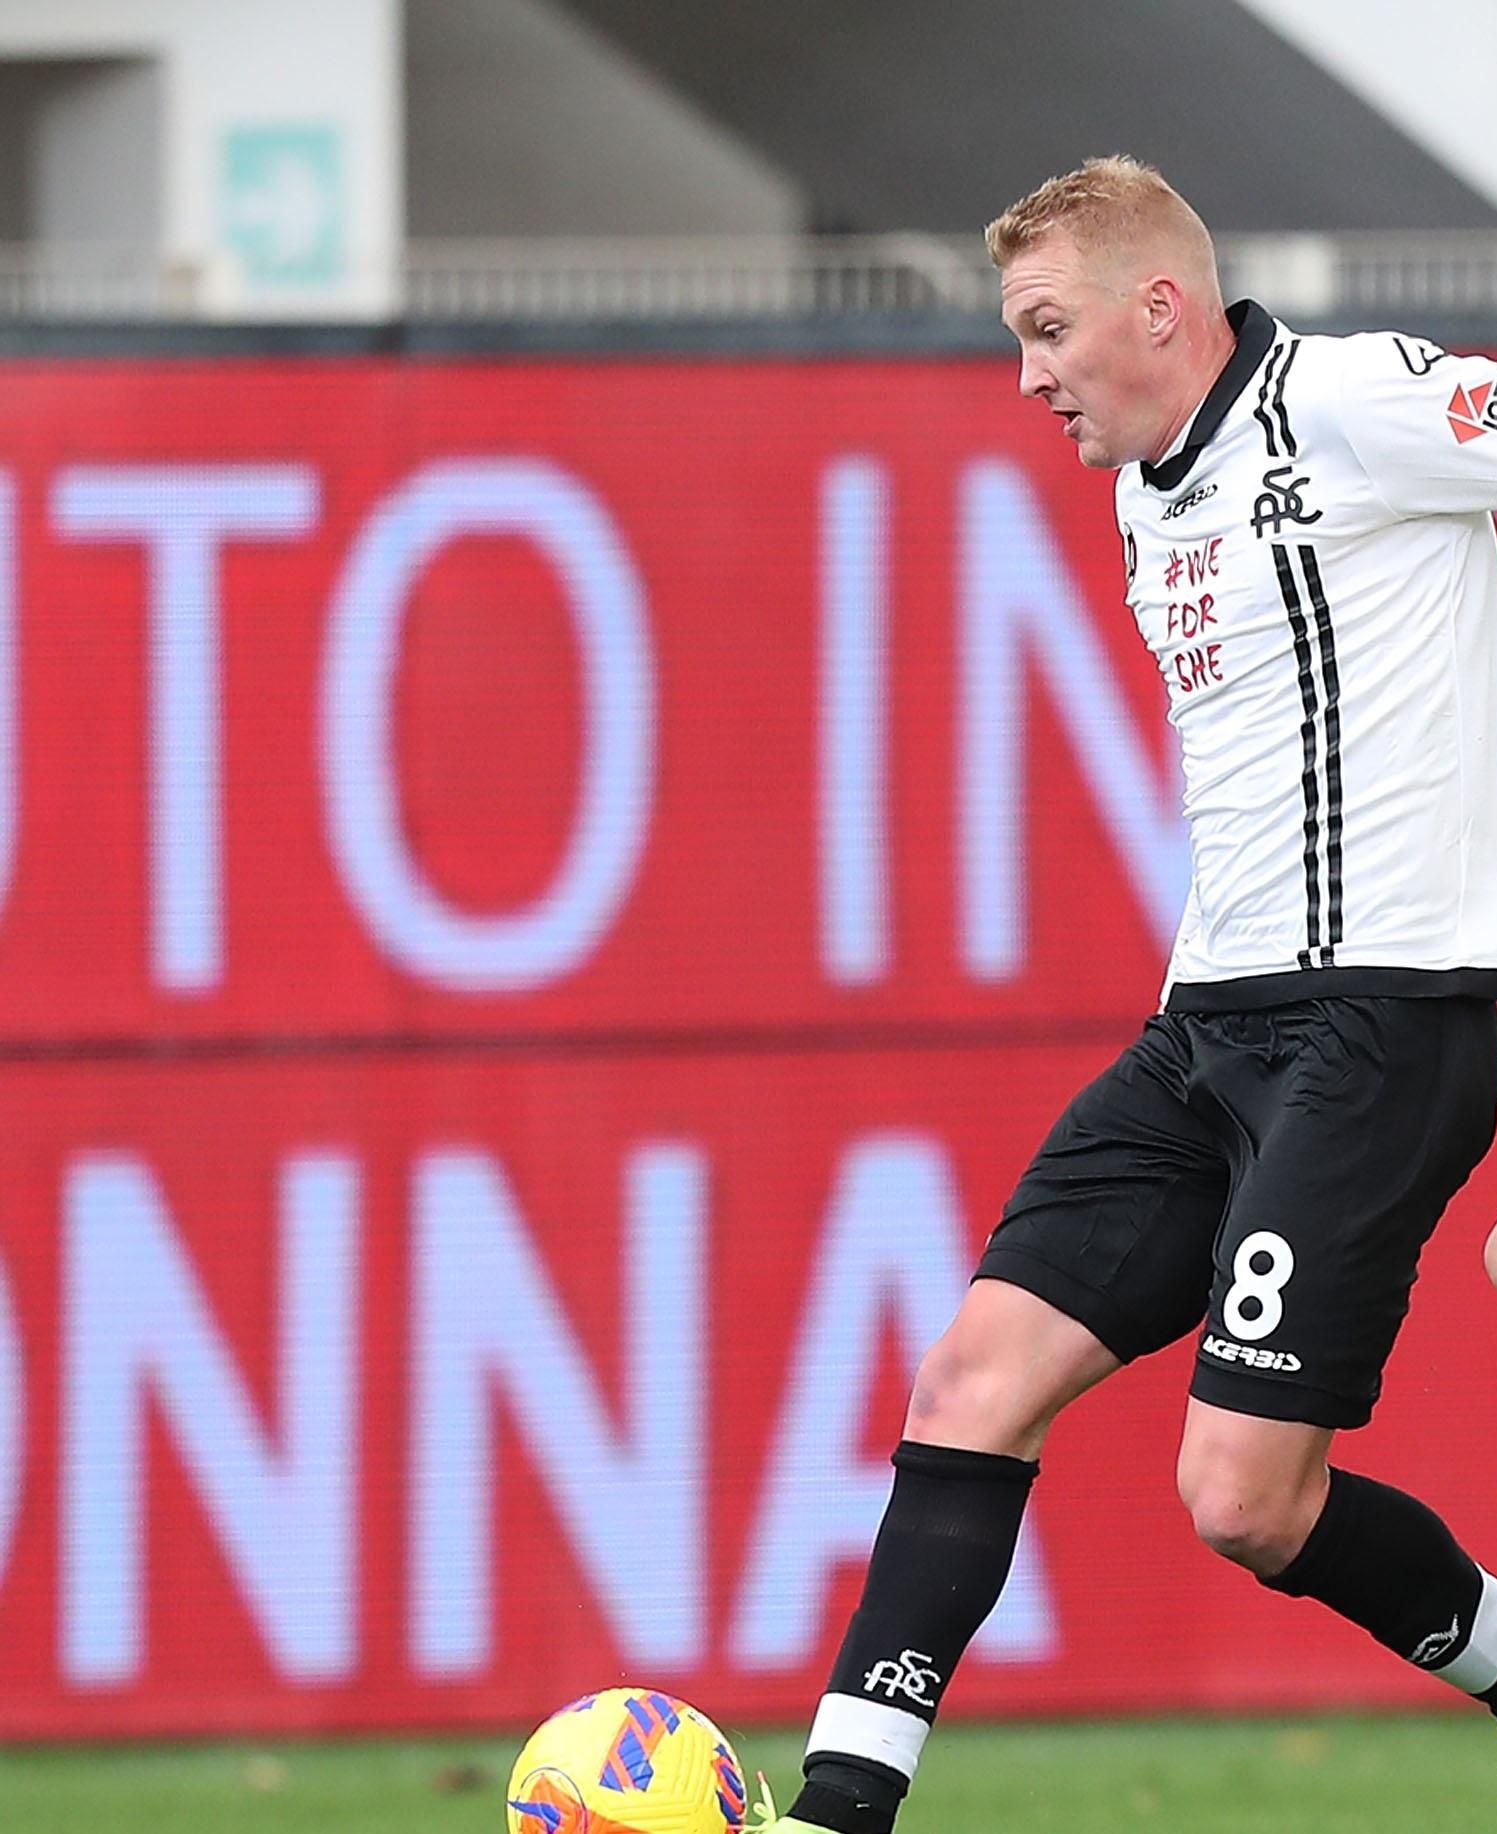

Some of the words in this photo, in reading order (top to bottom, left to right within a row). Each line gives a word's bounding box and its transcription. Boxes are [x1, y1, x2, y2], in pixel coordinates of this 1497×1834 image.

[1164, 537, 1223, 592] #WE
[1167, 593, 1218, 641] FOR
[1174, 643, 1223, 692] SHE
[0, 450, 660, 1000] TO
[1223, 1231, 1294, 1341] 8
[0, 1130, 1062, 1690] NNA
